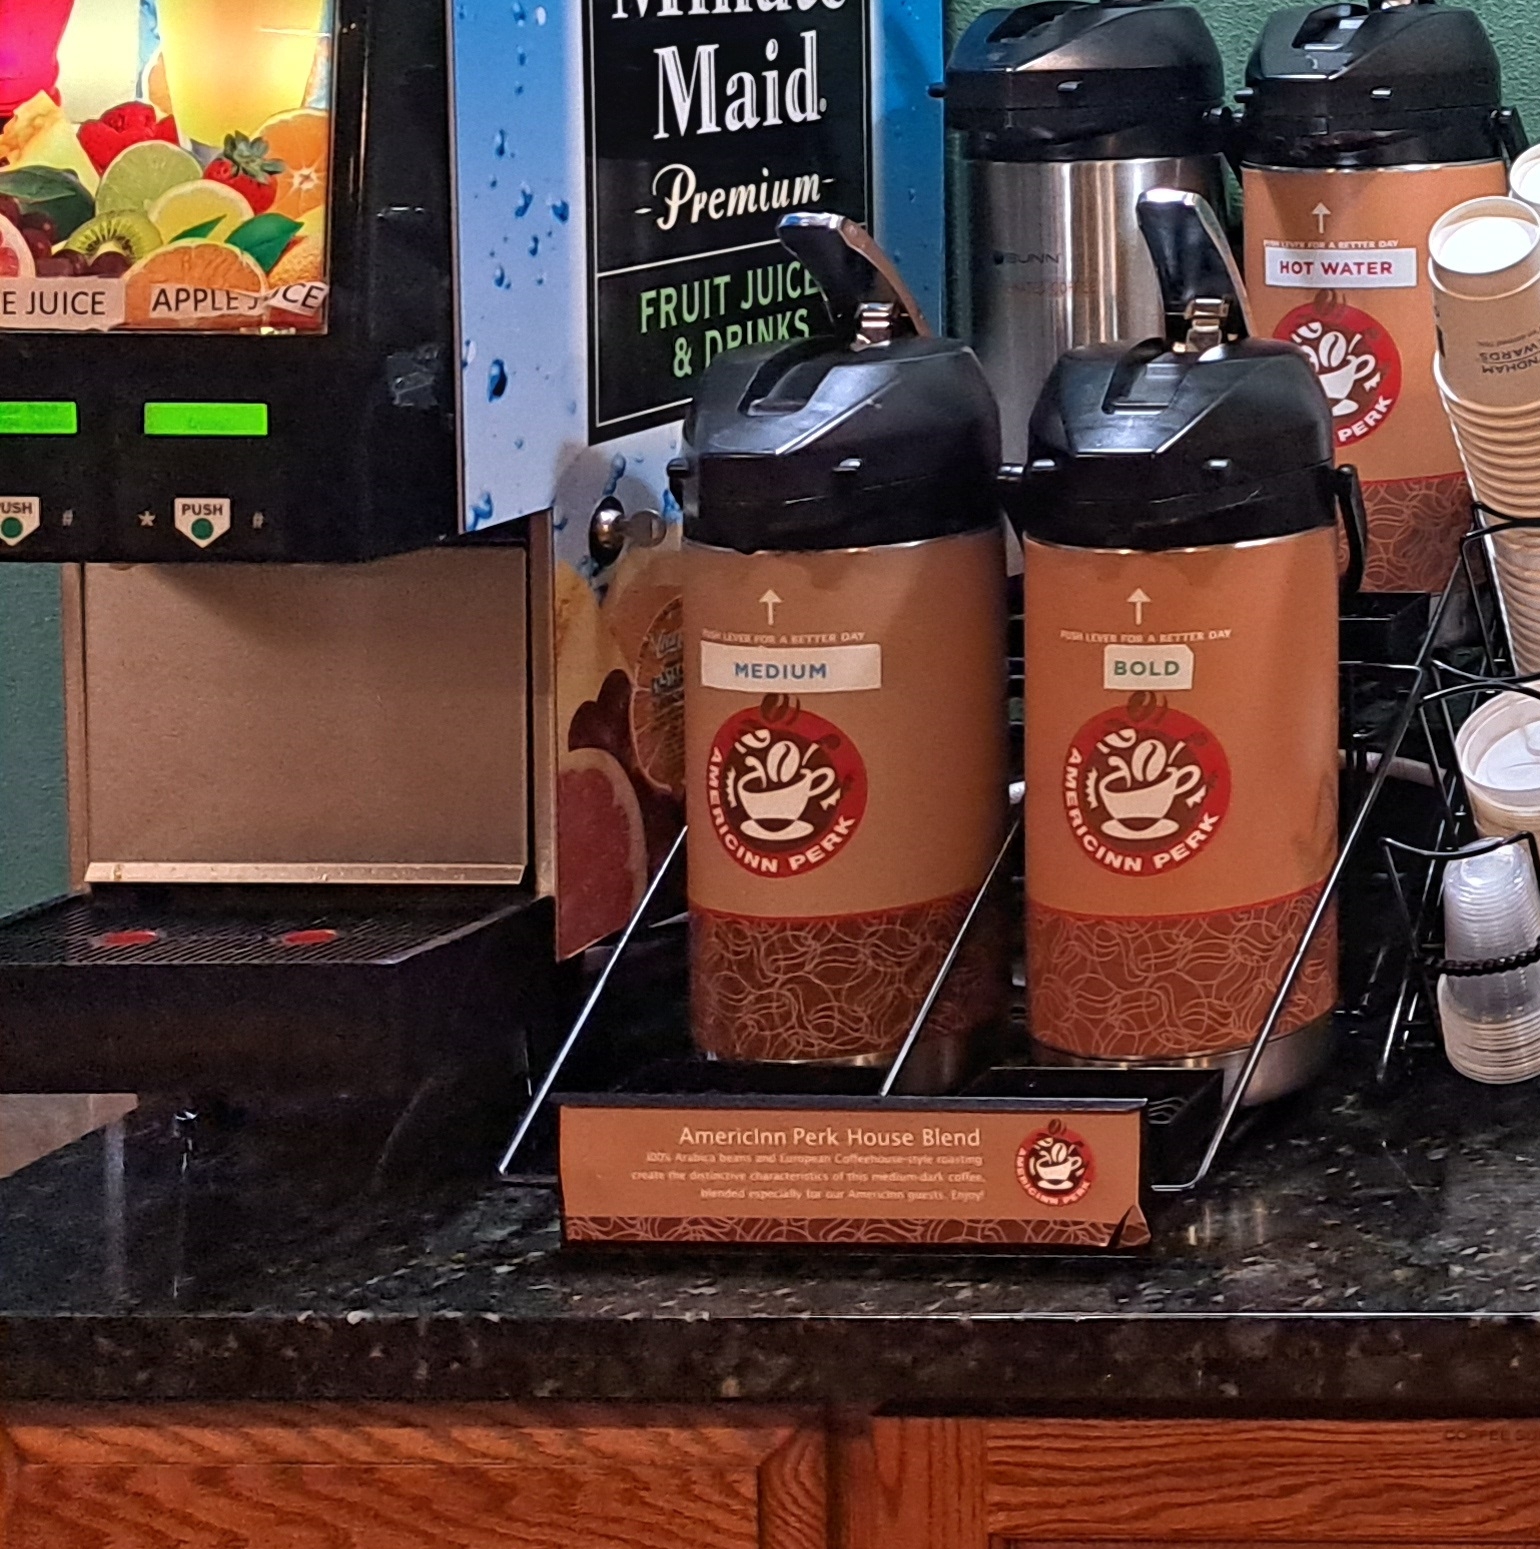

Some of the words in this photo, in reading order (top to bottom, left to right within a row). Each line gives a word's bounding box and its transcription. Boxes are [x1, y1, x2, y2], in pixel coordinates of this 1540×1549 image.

[653, 29, 826, 140] Maid
[1279, 260, 1314, 275] HOT
[1320, 260, 1393, 276] WATER
[26, 290, 106, 316] JUICE
[152, 287, 239, 312] APPLE
[639, 274, 732, 334] FRUIT
[740, 260, 821, 311] JUICE
[672, 336, 693, 378] &
[1337, 395, 1393, 442] PERK
[0, 502, 33, 514] USH
[181, 503, 223, 516] PUSH
[754, 634, 775, 643] FOR
[780, 635, 788, 644] A
[791, 633, 836, 644] BETTER
[841, 631, 865, 641] DAY
[1085, 633, 1117, 643] LEVER
[1120, 634, 1143, 643] FOR
[1147, 635, 1156, 643] A
[1159, 632, 1204, 643] BETTER
[1208, 629, 1232, 640] DAY
[734, 662, 827, 679] MEDIUM
[1114, 660, 1180, 677] BOLD
[709, 746, 778, 873] AMERICINN
[789, 815, 856, 871] PERK
[1064, 747, 1142, 872] AMERICINN
[1153, 811, 1220, 870] PERK
[679, 1127, 787, 1146] AmericInn
[794, 1127, 839, 1146] Perk
[847, 1128, 914, 1147] House
[922, 1128, 981, 1147] Blend
[719, 1153, 751, 1164] beans
[755, 1154, 777, 1164] and
[780, 1154, 831, 1166] European
[936, 1155, 983, 1167] roasting
[631, 1171, 665, 1181] create
[668, 1170, 686, 1181] the
[689, 1170, 746, 1182] distinctive
[750, 1171, 829, 1183] characteristics
[832, 1172, 844, 1182] of
[846, 1172, 868, 1183] this
[700, 1187, 745, 1199] blended
[749, 1188, 802, 1201] especially
[825, 1191, 845, 1200] our
